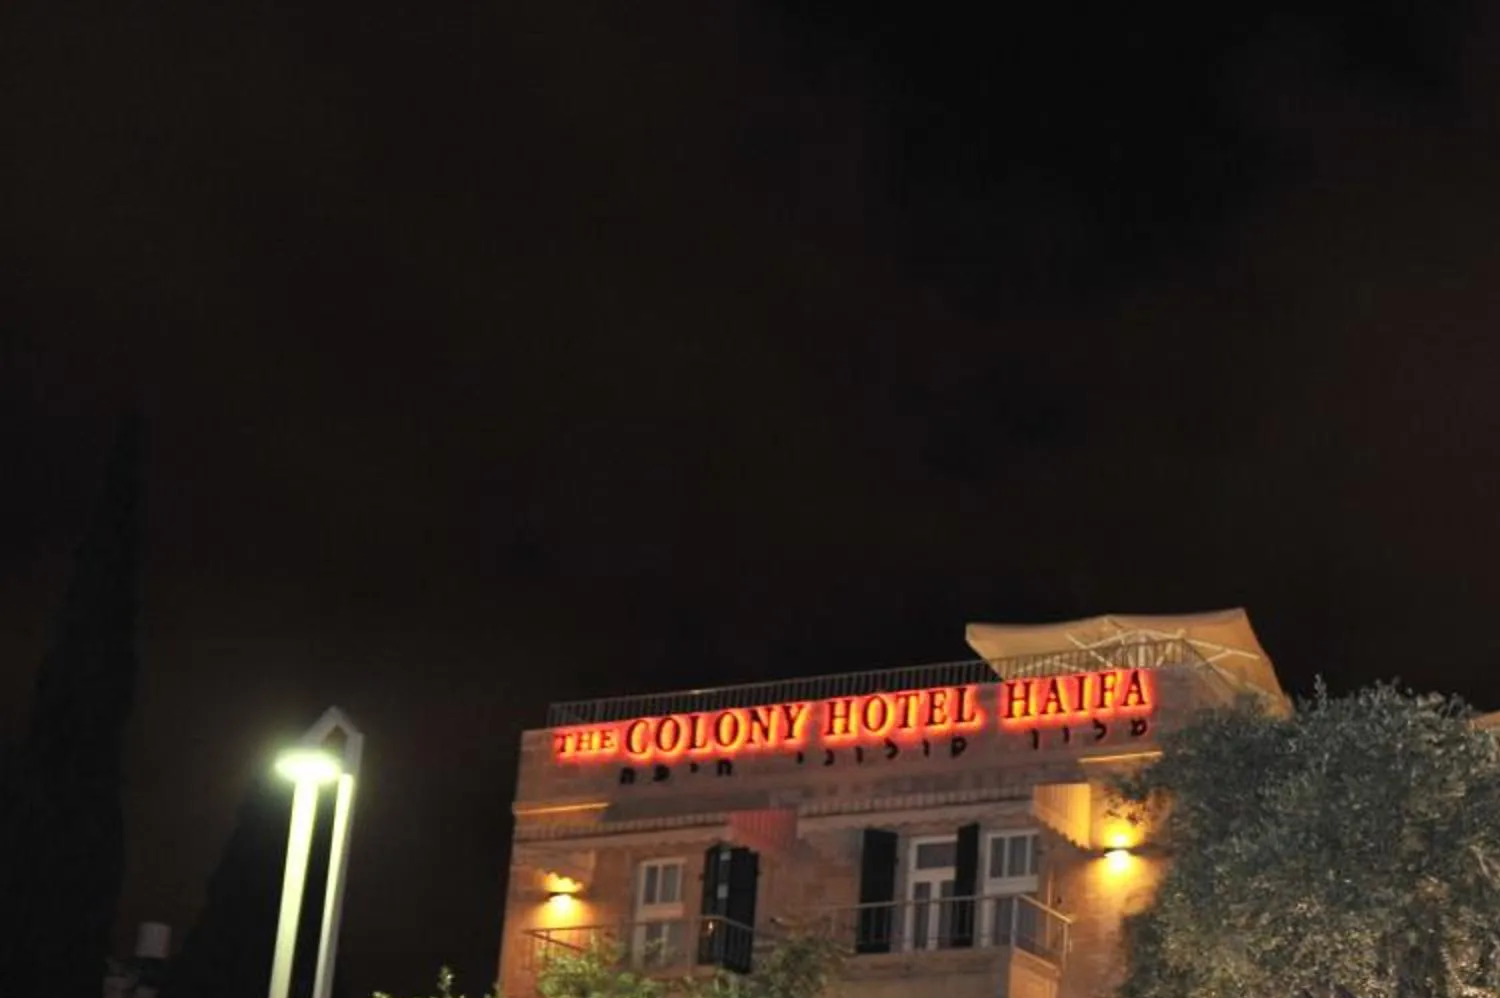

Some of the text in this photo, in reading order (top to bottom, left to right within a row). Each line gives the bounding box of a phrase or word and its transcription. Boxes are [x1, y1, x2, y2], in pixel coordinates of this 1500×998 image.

[553, 669, 1148, 755] THE COLONY HOTEL HAIFA
[619, 717, 1148, 785] מלון קולוני חיפה
